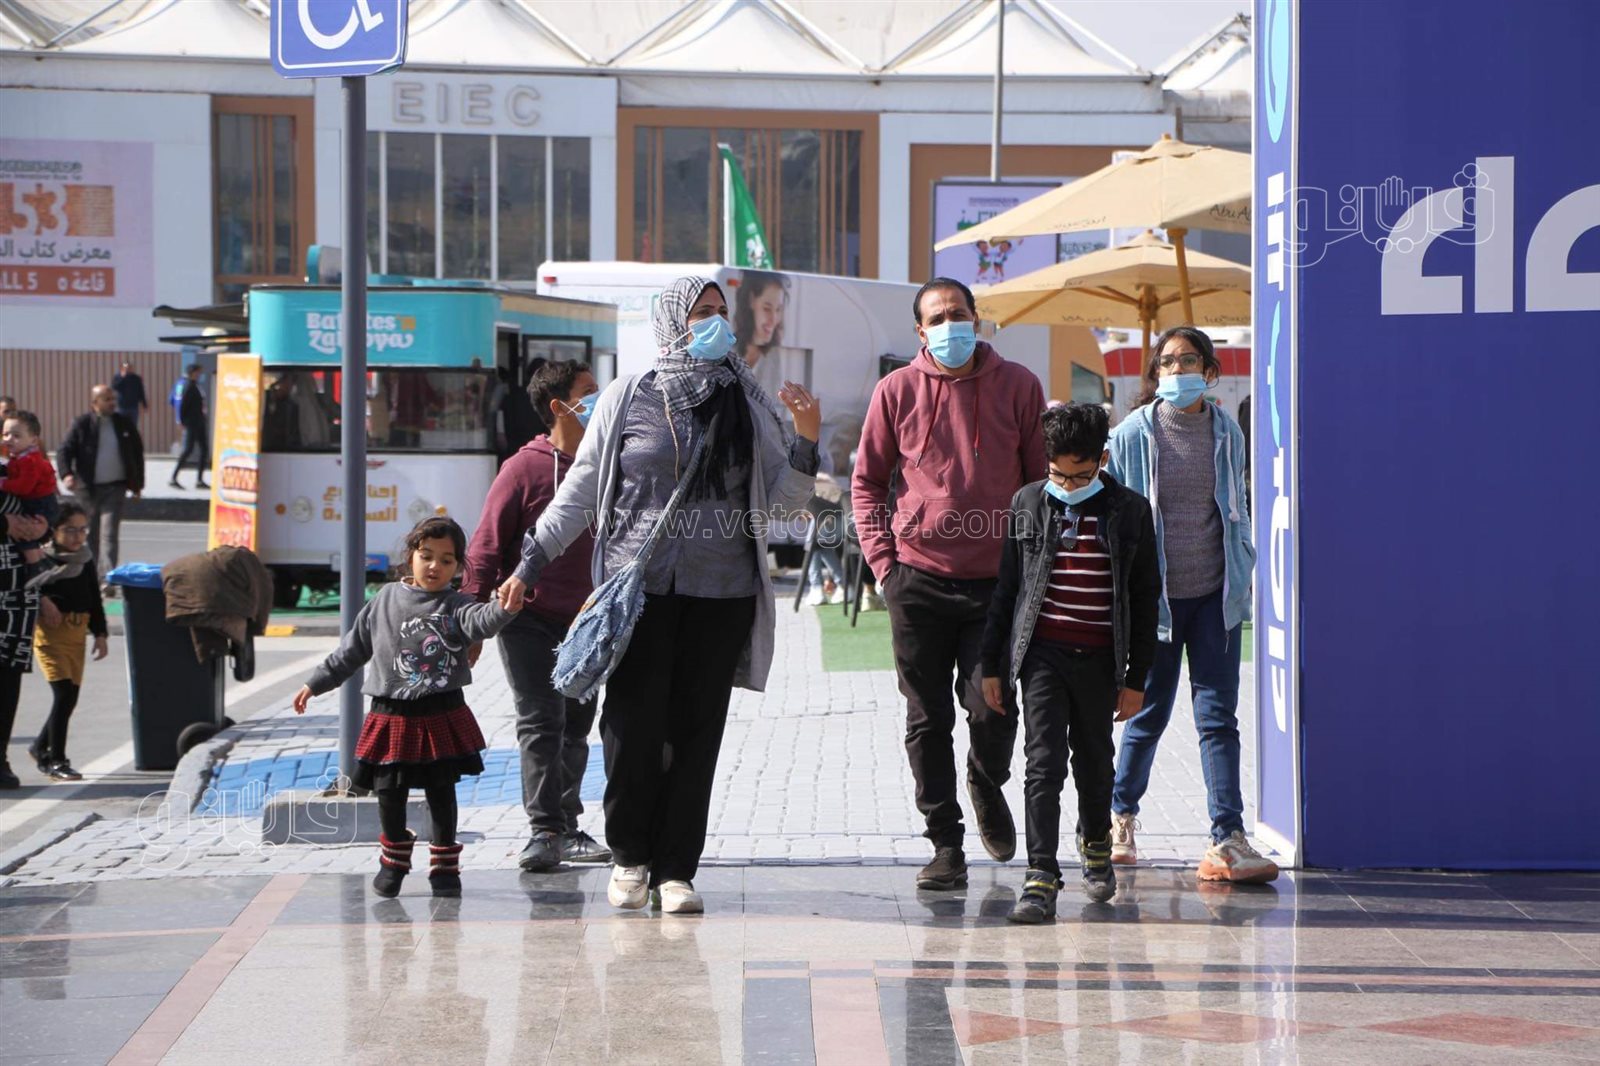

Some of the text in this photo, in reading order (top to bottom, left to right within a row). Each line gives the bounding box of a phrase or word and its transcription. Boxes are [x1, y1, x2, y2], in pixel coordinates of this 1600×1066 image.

[392, 81, 541, 127] EIEC
[18, 239, 56, 263] كتاب
[60, 242, 112, 263] معرض
[0, 271, 38, 291] LL 5
[72, 271, 106, 292] قاعة
